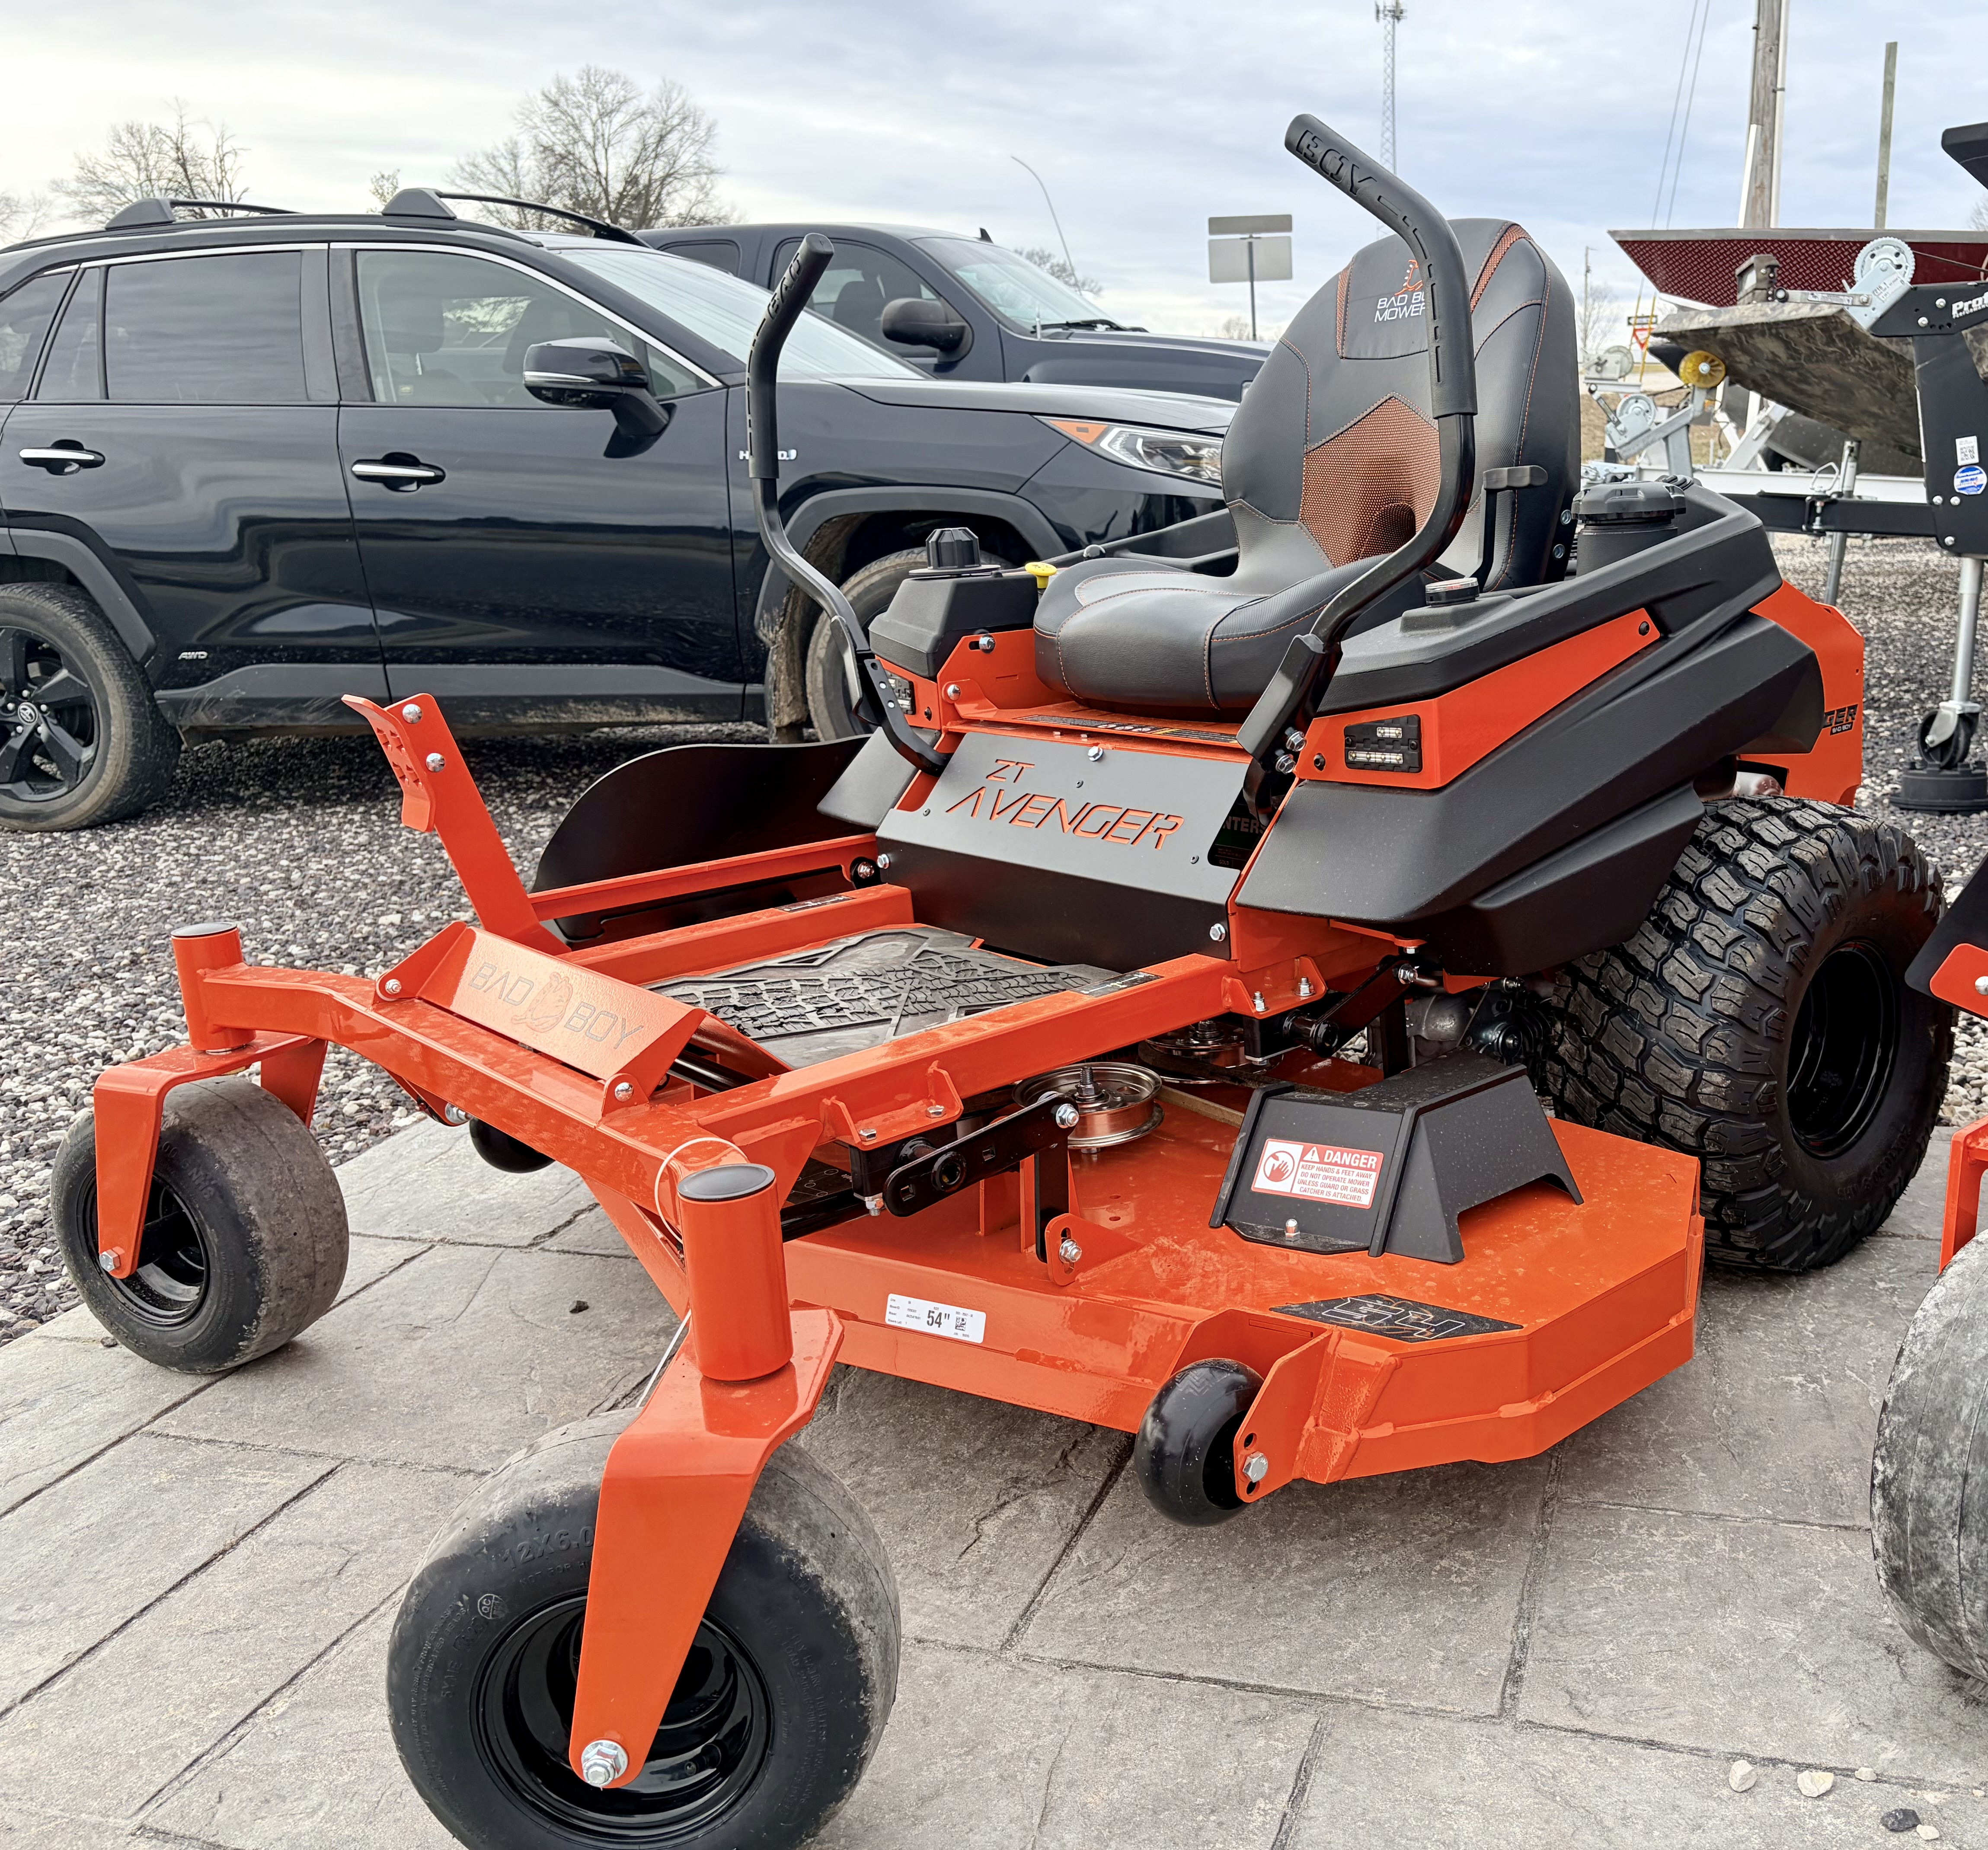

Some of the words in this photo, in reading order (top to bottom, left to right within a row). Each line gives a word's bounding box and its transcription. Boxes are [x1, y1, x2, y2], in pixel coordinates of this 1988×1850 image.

[1296, 130, 1377, 196] BOY
[1377, 294, 1408, 309] BAD
[1374, 303, 1425, 323] MOWER
[178, 651, 208, 660] AWD
[1823, 704, 1858, 728] GER
[986, 759, 1035, 783] ZT
[946, 786, 1185, 850] AVENGER
[468, 962, 534, 1006] BAD
[564, 1001, 644, 1050] BOY
[1323, 1150, 1377, 1169] DANGER
[1316, 1166, 1335, 1174] HANDS
[1297, 1179, 1319, 1187] UNLESS
[1320, 1182, 1339, 1190] GUARD
[1349, 1186, 1369, 1195] GRASS
[1322, 1174, 1346, 1184] OPERATE
[1348, 1178, 1370, 1187] MOWER
[1300, 1186, 1324, 1195] CATCHER
[1332, 1192, 1362, 1202] ATTACHED.
[927, 1310, 950, 1328] 54"
[1321, 1297, 1466, 1339] 54
